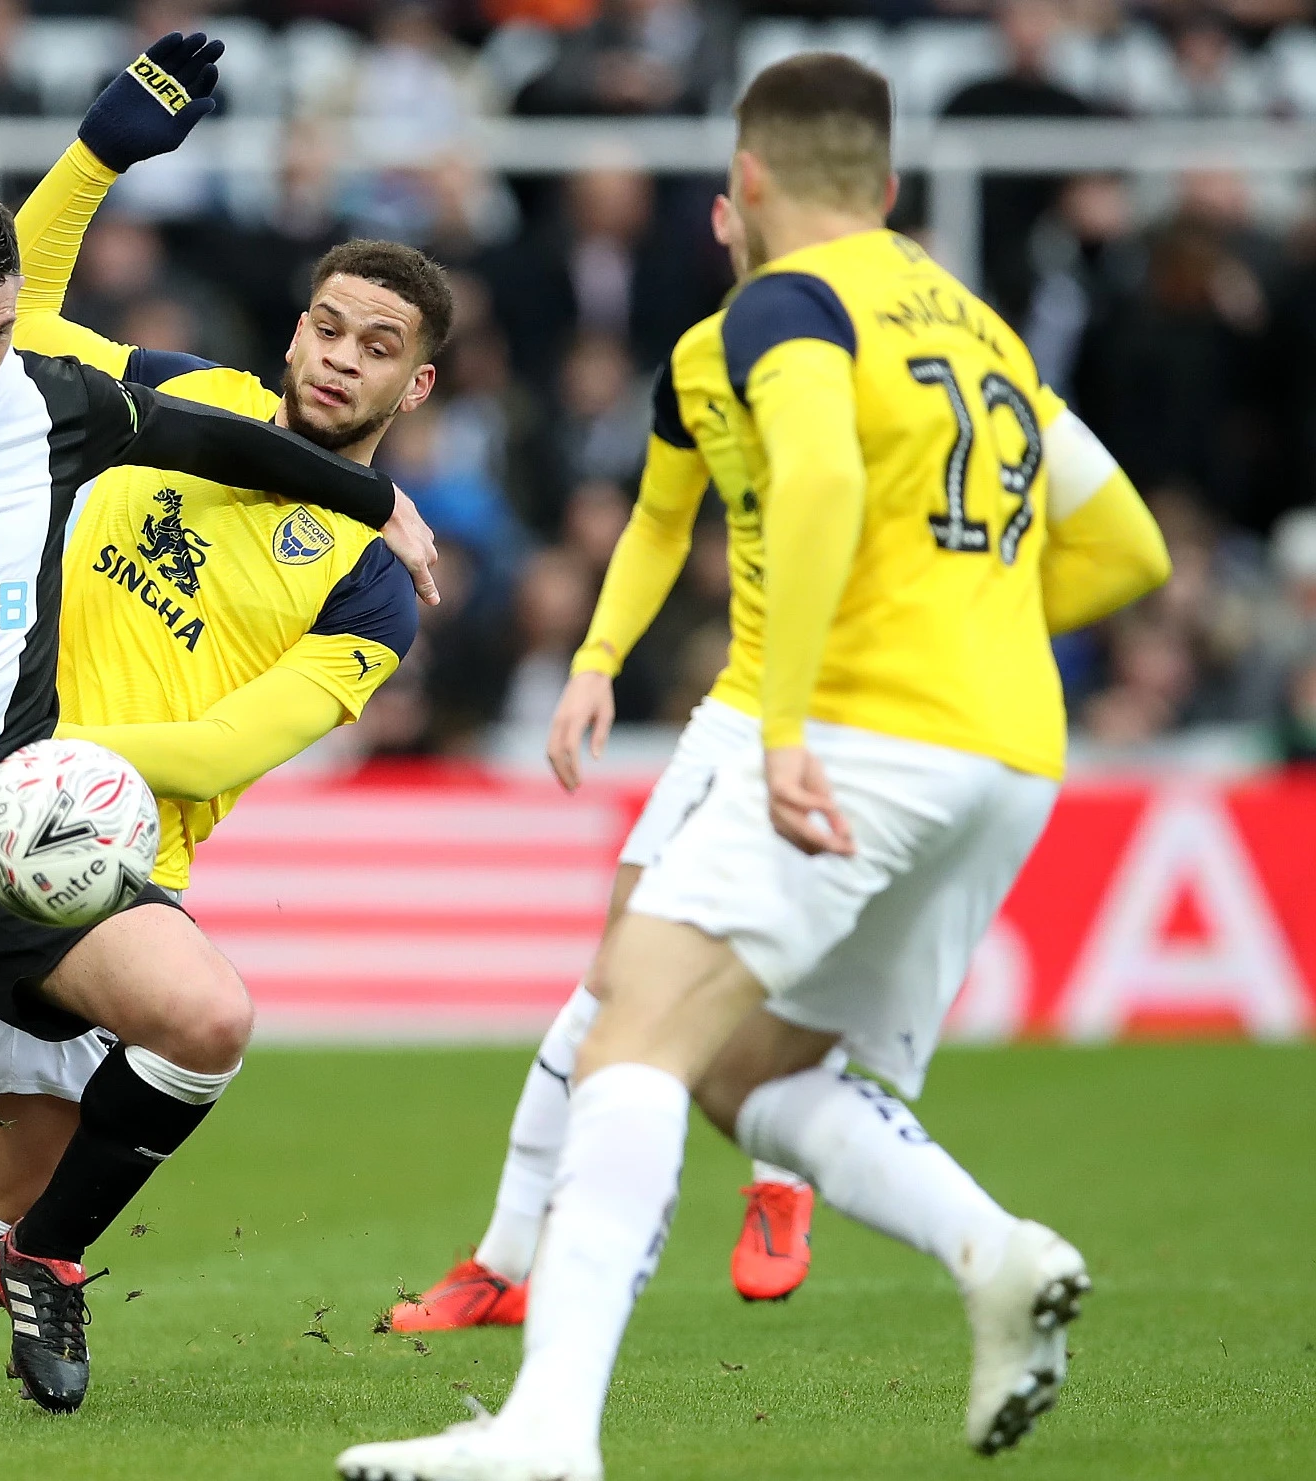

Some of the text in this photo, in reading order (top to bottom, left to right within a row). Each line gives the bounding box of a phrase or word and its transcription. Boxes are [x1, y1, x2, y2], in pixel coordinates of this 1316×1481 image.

[134, 62, 187, 112] OUFC
[906, 357, 1042, 566] 19
[297, 512, 330, 545] OXFORD
[298, 524, 317, 543] UNITED
[93, 543, 206, 653] SINGHA
[46, 857, 107, 910] mitre
